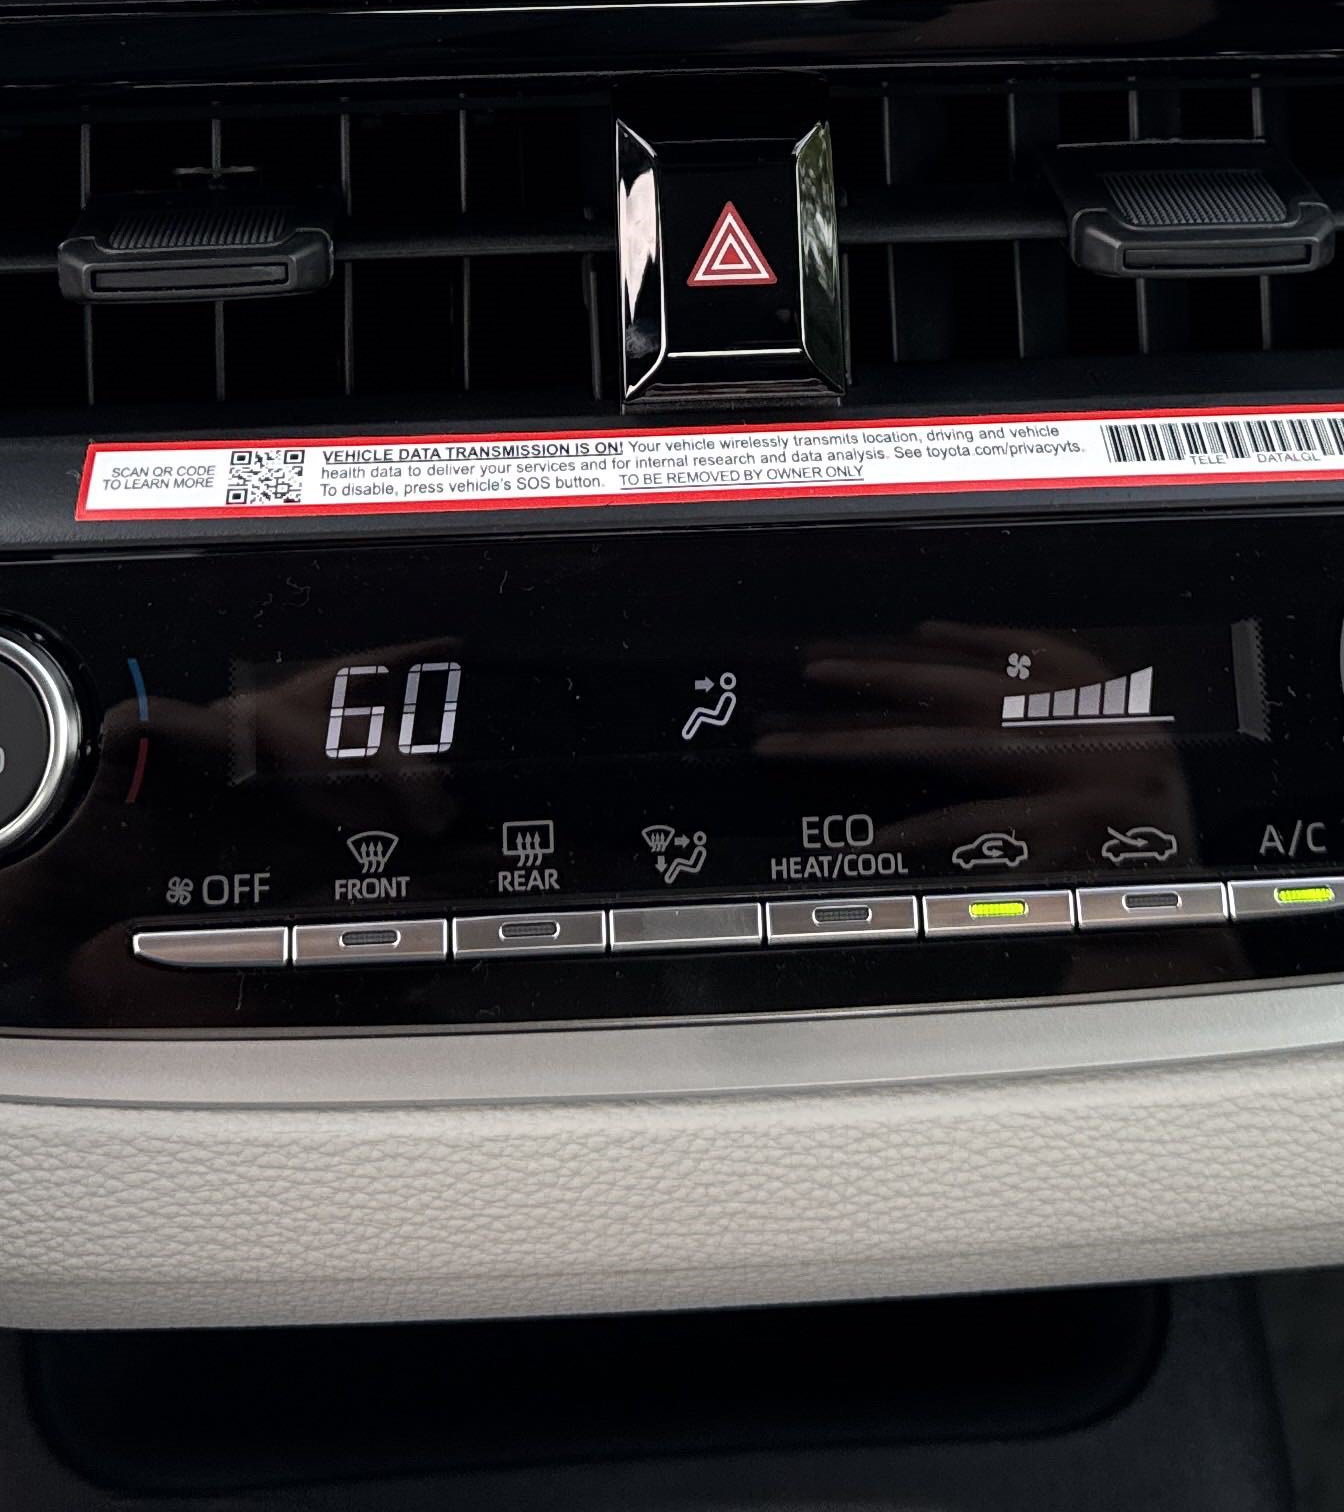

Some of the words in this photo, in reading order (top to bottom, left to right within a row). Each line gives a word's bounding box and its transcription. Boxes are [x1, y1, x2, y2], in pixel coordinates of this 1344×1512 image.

[323, 448, 393, 464] VEHICLE
[399, 446, 442, 462] DATA
[446, 442, 571, 461] TRANSMISSION
[575, 442, 590, 456] IS
[594, 441, 623, 455] ON!
[628, 439, 660, 454] Your
[666, 436, 715, 452] vehicle
[719, 433, 789, 452] wirelessly
[793, 431, 858, 447] transmits
[862, 428, 923, 445] location,
[927, 426, 974, 445] driving
[979, 425, 1005, 439] and
[1009, 424, 1060, 439] vehicle
[111, 465, 152, 478] SCAN
[155, 465, 179, 477] QR
[182, 464, 216, 476] CODE
[321, 465, 366, 480] health
[370, 463, 402, 478] data
[407, 463, 422, 477] to
[426, 461, 476, 477] deliver
[479, 463, 513, 480] your
[516, 459, 576, 474] services
[580, 457, 607, 471] and
[611, 455, 631, 470] for
[635, 451, 689, 469] internal
[692, 449, 756, 466] research
[760, 448, 787, 463] and
[791, 447, 823, 462] data
[827, 444, 890, 463] analysis.
[894, 444, 923, 459] See
[1189, 453, 1225, 465] TELE
[103, 479, 120, 490] TO
[123, 476, 170, 489] LEARN
[172, 474, 214, 489] MORE
[320, 482, 337, 497] To
[341, 479, 399, 497] disable,
[403, 480, 445, 498] press
[448, 474, 512, 493] vehicle's
[516, 474, 551, 491] SOS
[555, 472, 604, 489] button.
[619, 471, 639, 487] TO
[643, 470, 662, 486] BE
[666, 467, 741, 485] REMOVED
[743, 468, 763, 482] BY
[766, 466, 823, 481] OWNER
[825, 462, 864, 479] ONLY
[325, 662, 462, 759] 60
[801, 813, 875, 849] ECO
[1259, 821, 1328, 858] A/C
[498, 868, 560, 892] REAR
[770, 852, 909, 881] HEAT/COOL
[202, 872, 271, 906] OFF
[334, 876, 411, 900] FRONT
